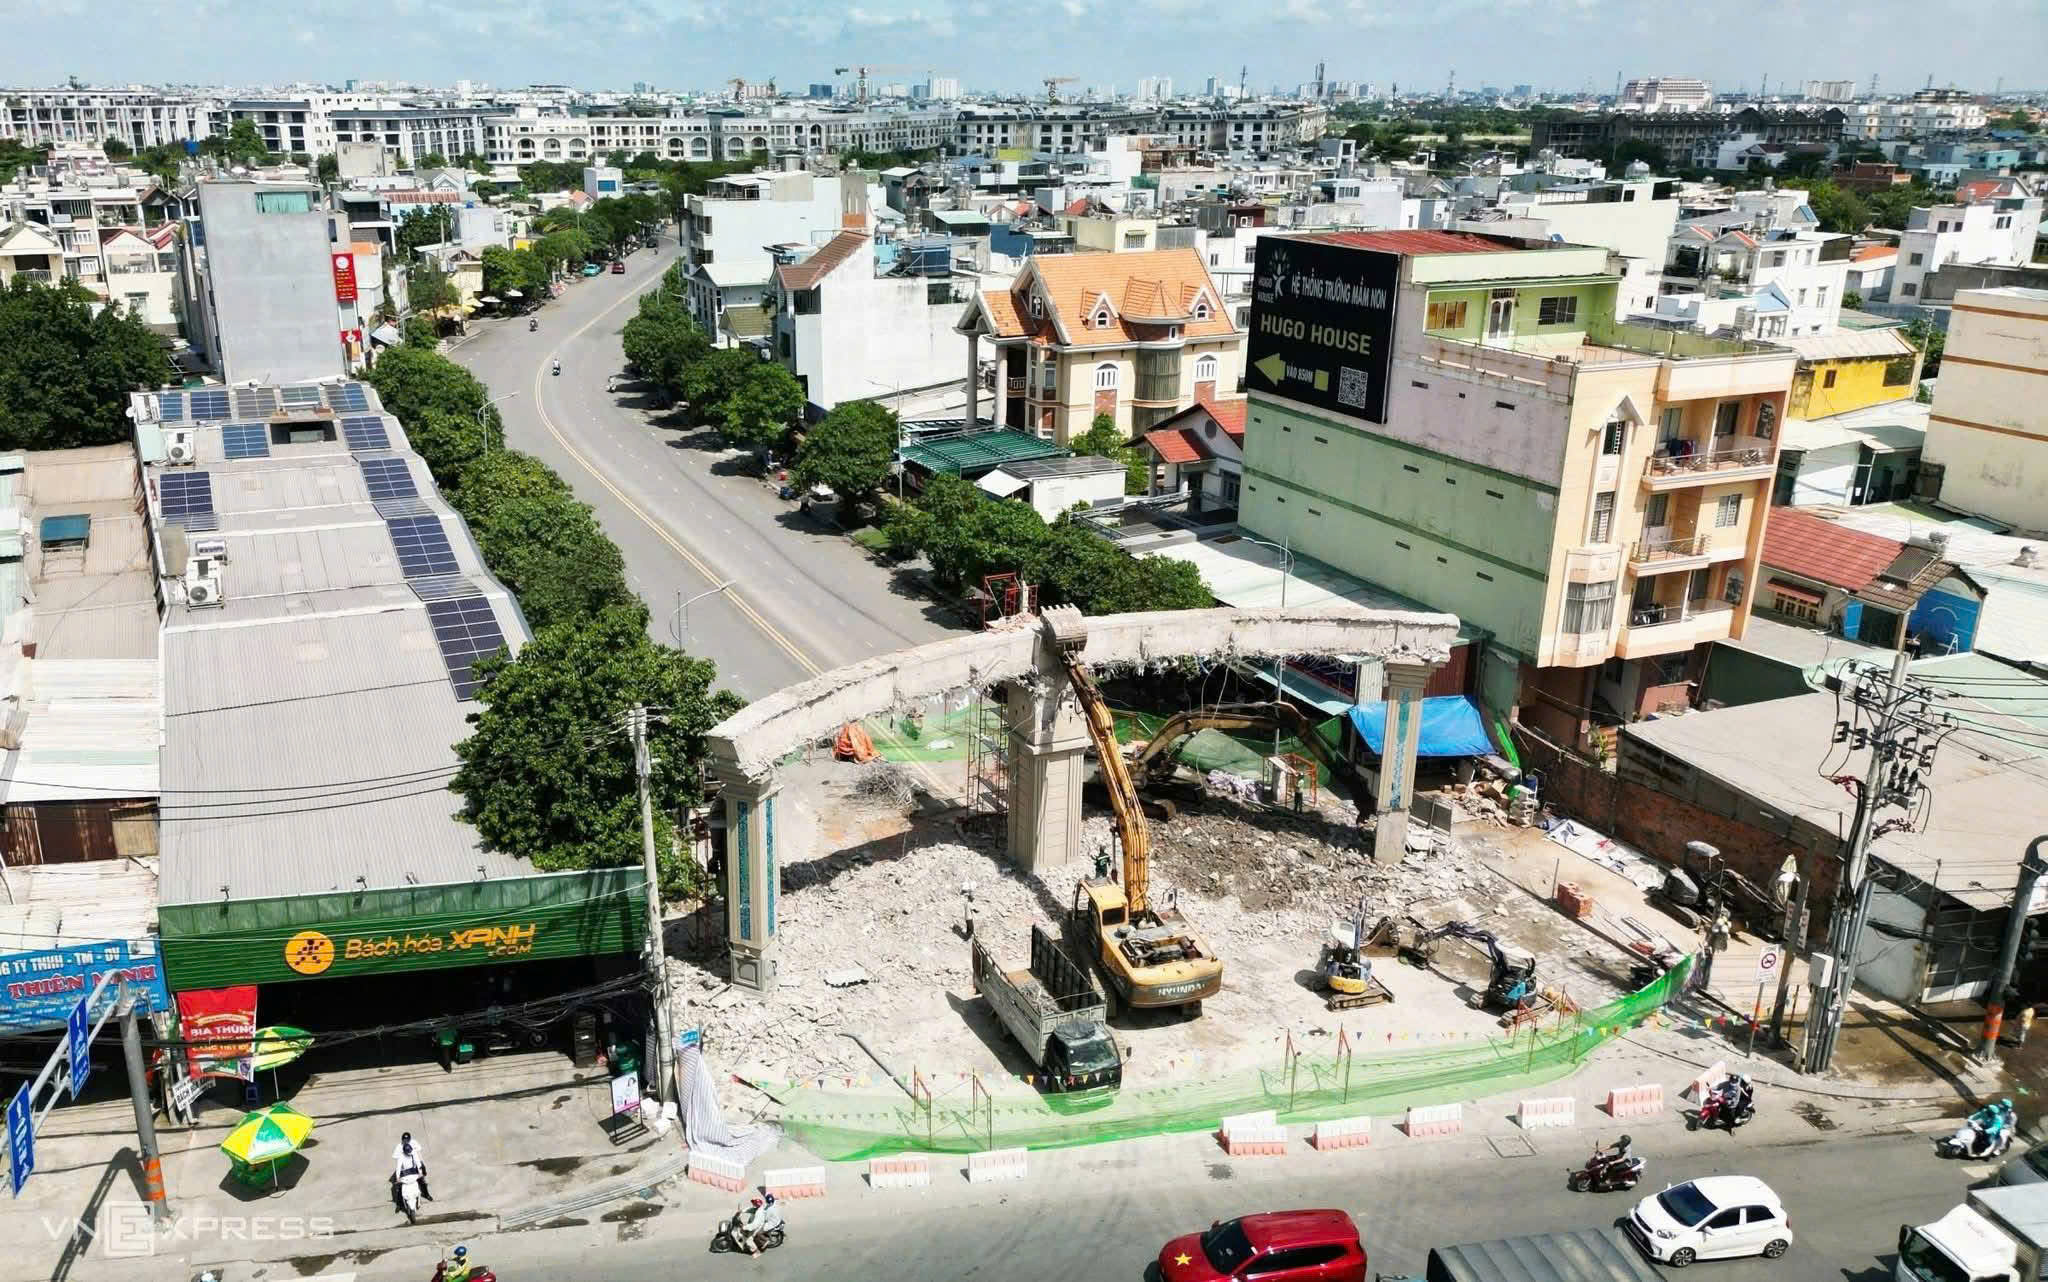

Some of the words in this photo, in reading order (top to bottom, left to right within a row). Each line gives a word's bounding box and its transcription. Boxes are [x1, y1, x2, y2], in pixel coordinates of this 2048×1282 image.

[1291, 272, 1302, 298] HỆ
[1302, 267, 1324, 299] THỐNG
[1370, 287, 1387, 310] NON
[1260, 313, 1305, 340] HUGO
[1311, 323, 1372, 355] HOUSE
[345, 936, 399, 958] Bách
[403, 933, 443, 954] hóa
[447, 923, 536, 950] XANH
[13, 959, 27, 974] TY
[73, 951, 94, 965] TM
[104, 947, 120, 962] DV
[7, 972, 85, 1000] THIÊN
[191, 1027, 212, 1036] BIA
